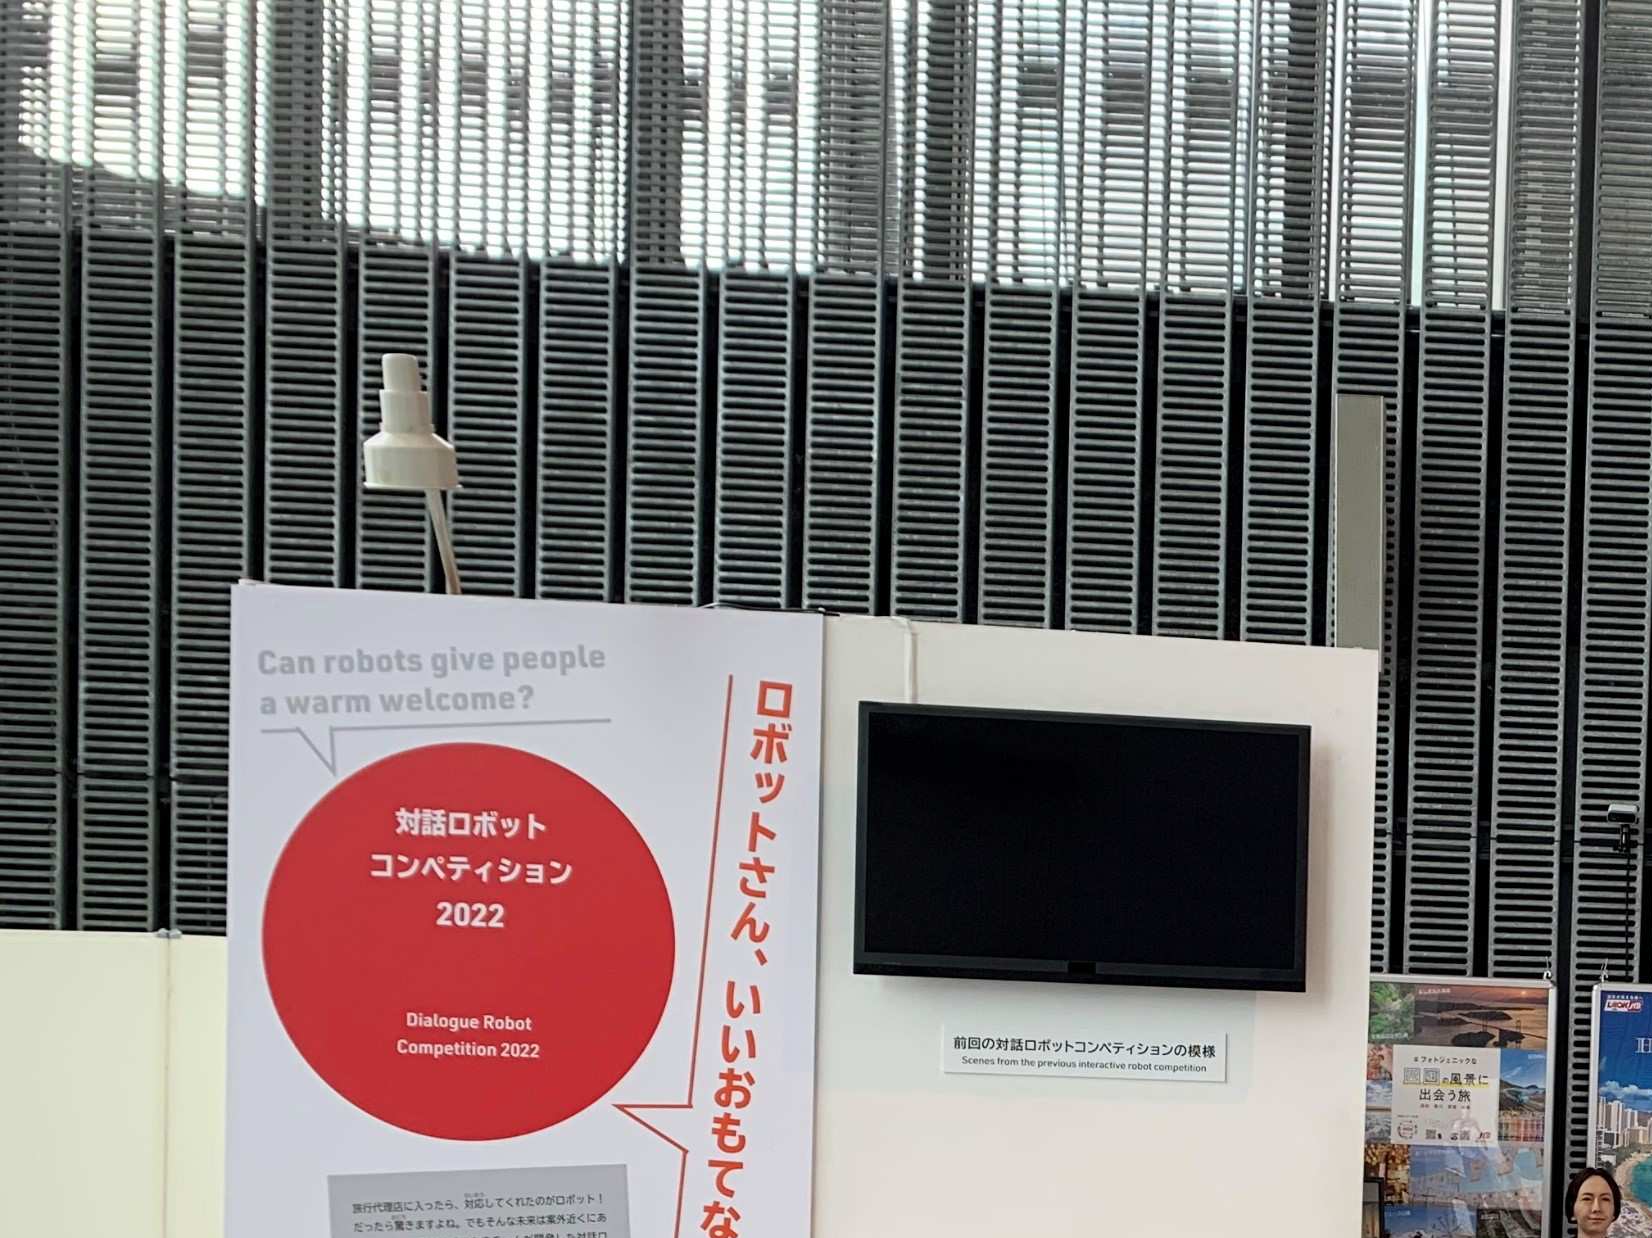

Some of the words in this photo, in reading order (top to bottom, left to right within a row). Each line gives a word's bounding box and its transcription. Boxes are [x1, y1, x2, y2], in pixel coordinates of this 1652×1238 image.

[258, 650, 315, 675] Can
[324, 648, 422, 674] robots
[431, 646, 494, 679] give
[502, 644, 606, 677] people
[260, 695, 277, 715] a
[286, 692, 371, 715] warm
[379, 685, 535, 713] welcome?
[394, 807, 547, 838] 対話ロボット
[370, 852, 573, 885] コンペティション
[436, 901, 505, 928] 2022
[406, 1012, 479, 1031] Dialogue
[483, 1013, 532, 1031] Robot
[396, 1038, 497, 1058] Competition
[500, 1041, 540, 1058] 2022
[953, 1036, 1216, 1059] 前回の対話ロボットコンペティションの模様
[961, 1055, 995, 1066] Scenes
[997, 1056, 1019, 1067] from
[1021, 1057, 1036, 1067] the
[1037, 1058, 1077, 1070] previous
[1078, 1059, 1126, 1070] interactive
[1128, 1061, 1152, 1071] robot
[1153, 1062, 1207, 1073] competition
[1419, 1088, 1471, 1102] 出会う旅
